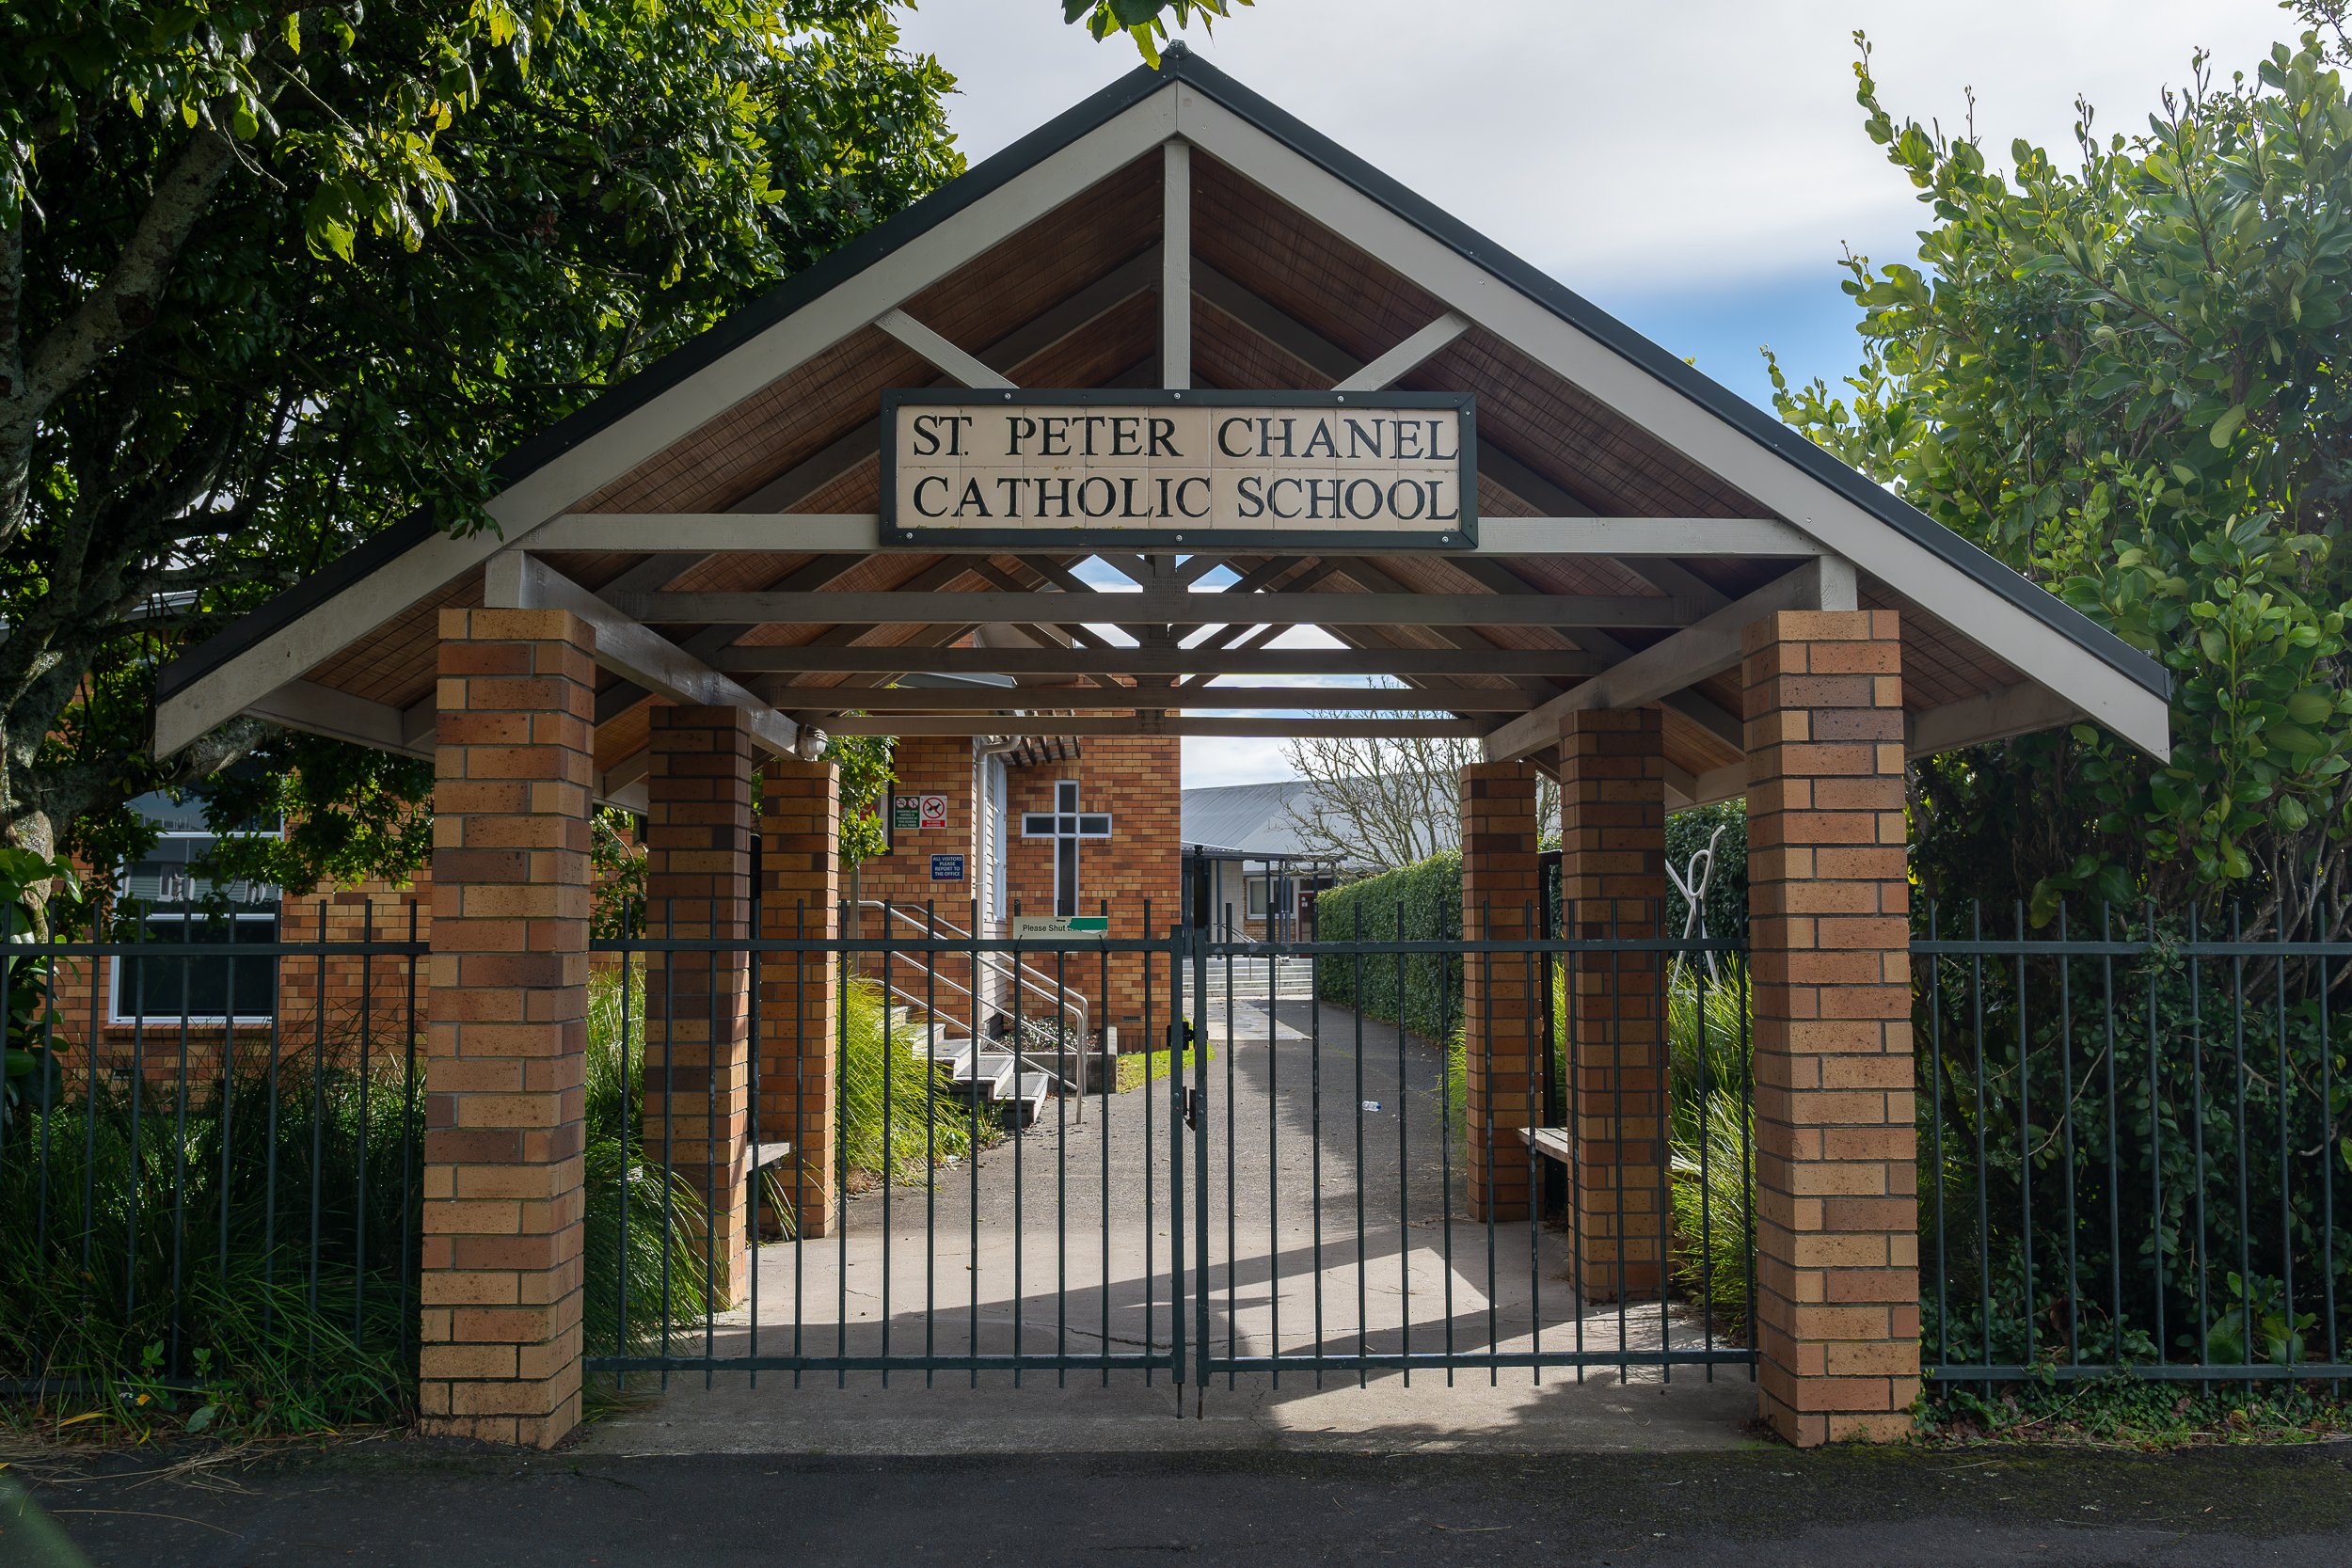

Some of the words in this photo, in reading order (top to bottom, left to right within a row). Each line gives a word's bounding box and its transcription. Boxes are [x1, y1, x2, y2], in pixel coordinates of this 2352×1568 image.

[912, 415, 973, 458] ST.
[1005, 417, 1184, 458] PETER
[1216, 416, 1459, 461] CHANEL
[913, 475, 1212, 520] CATHOLIC
[1236, 476, 1459, 521] SCHOOL
